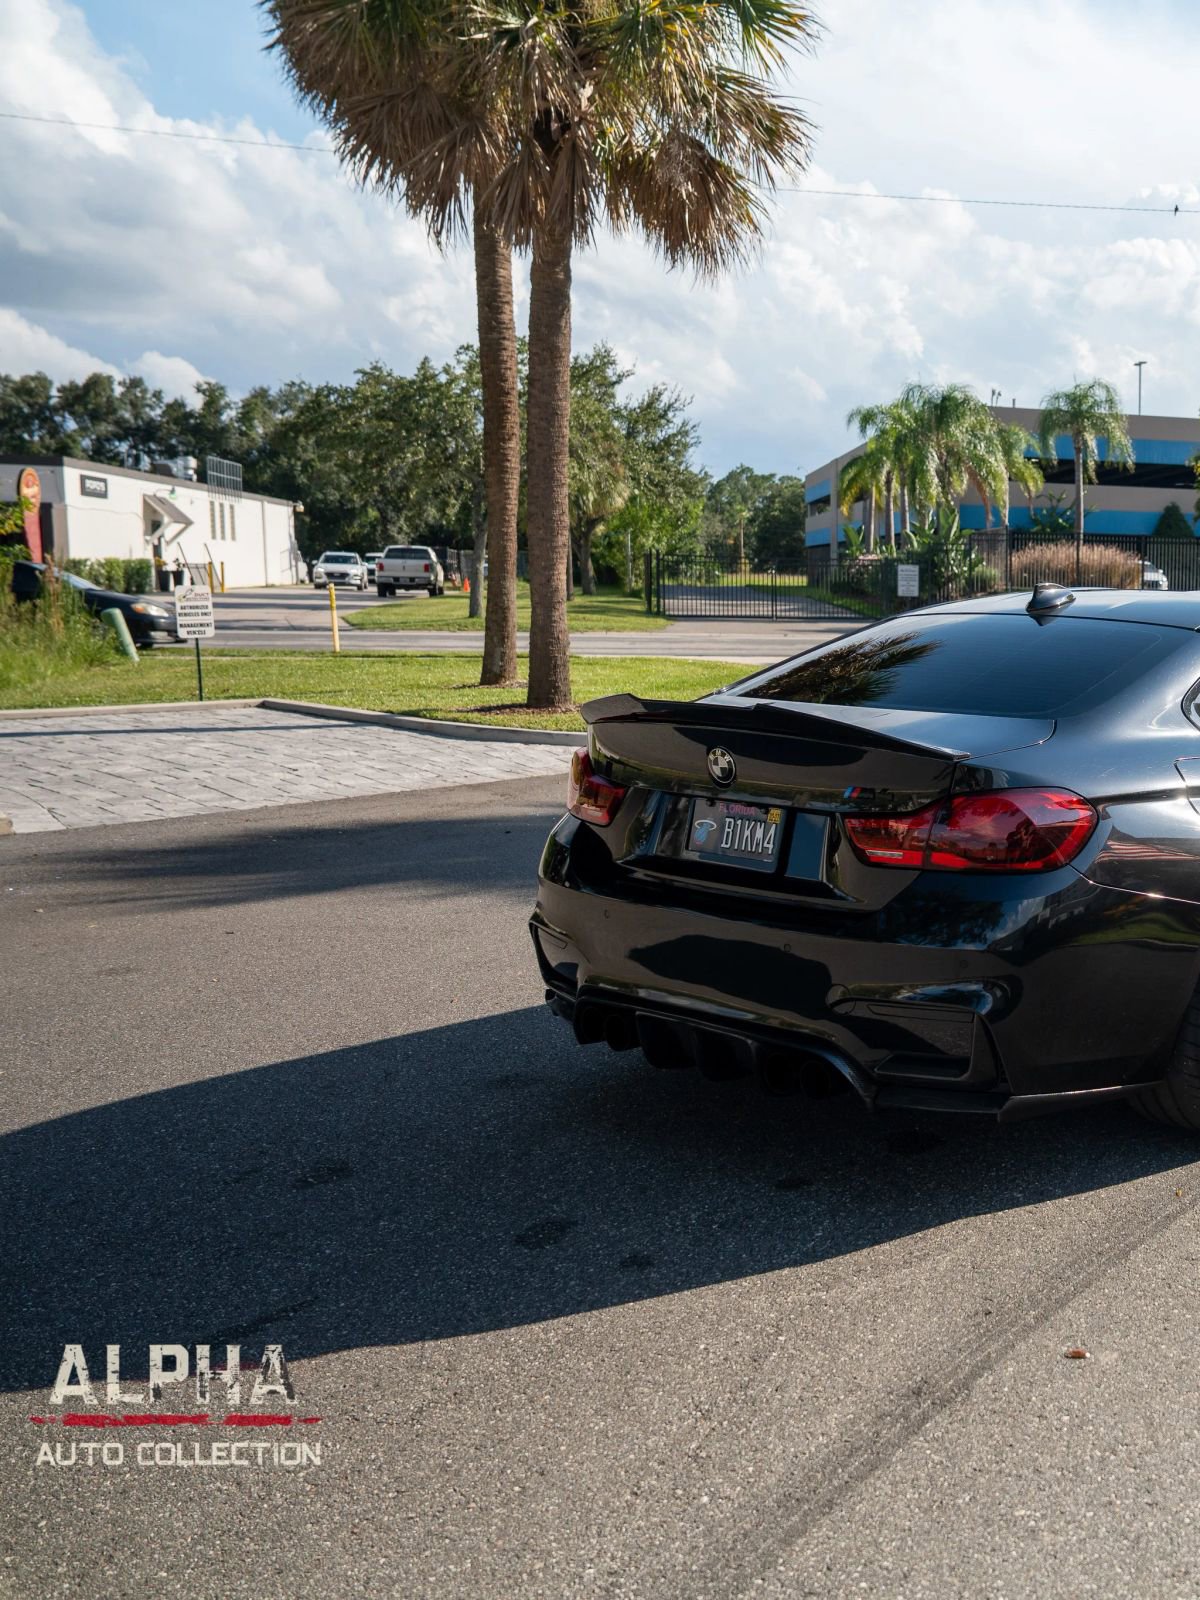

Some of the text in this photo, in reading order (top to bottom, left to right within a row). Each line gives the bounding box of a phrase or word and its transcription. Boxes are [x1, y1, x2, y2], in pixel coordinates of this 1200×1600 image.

[709, 749, 731, 762] BMW
[719, 801, 756, 816] FLORIDA
[721, 817, 777, 855] B1KM4
